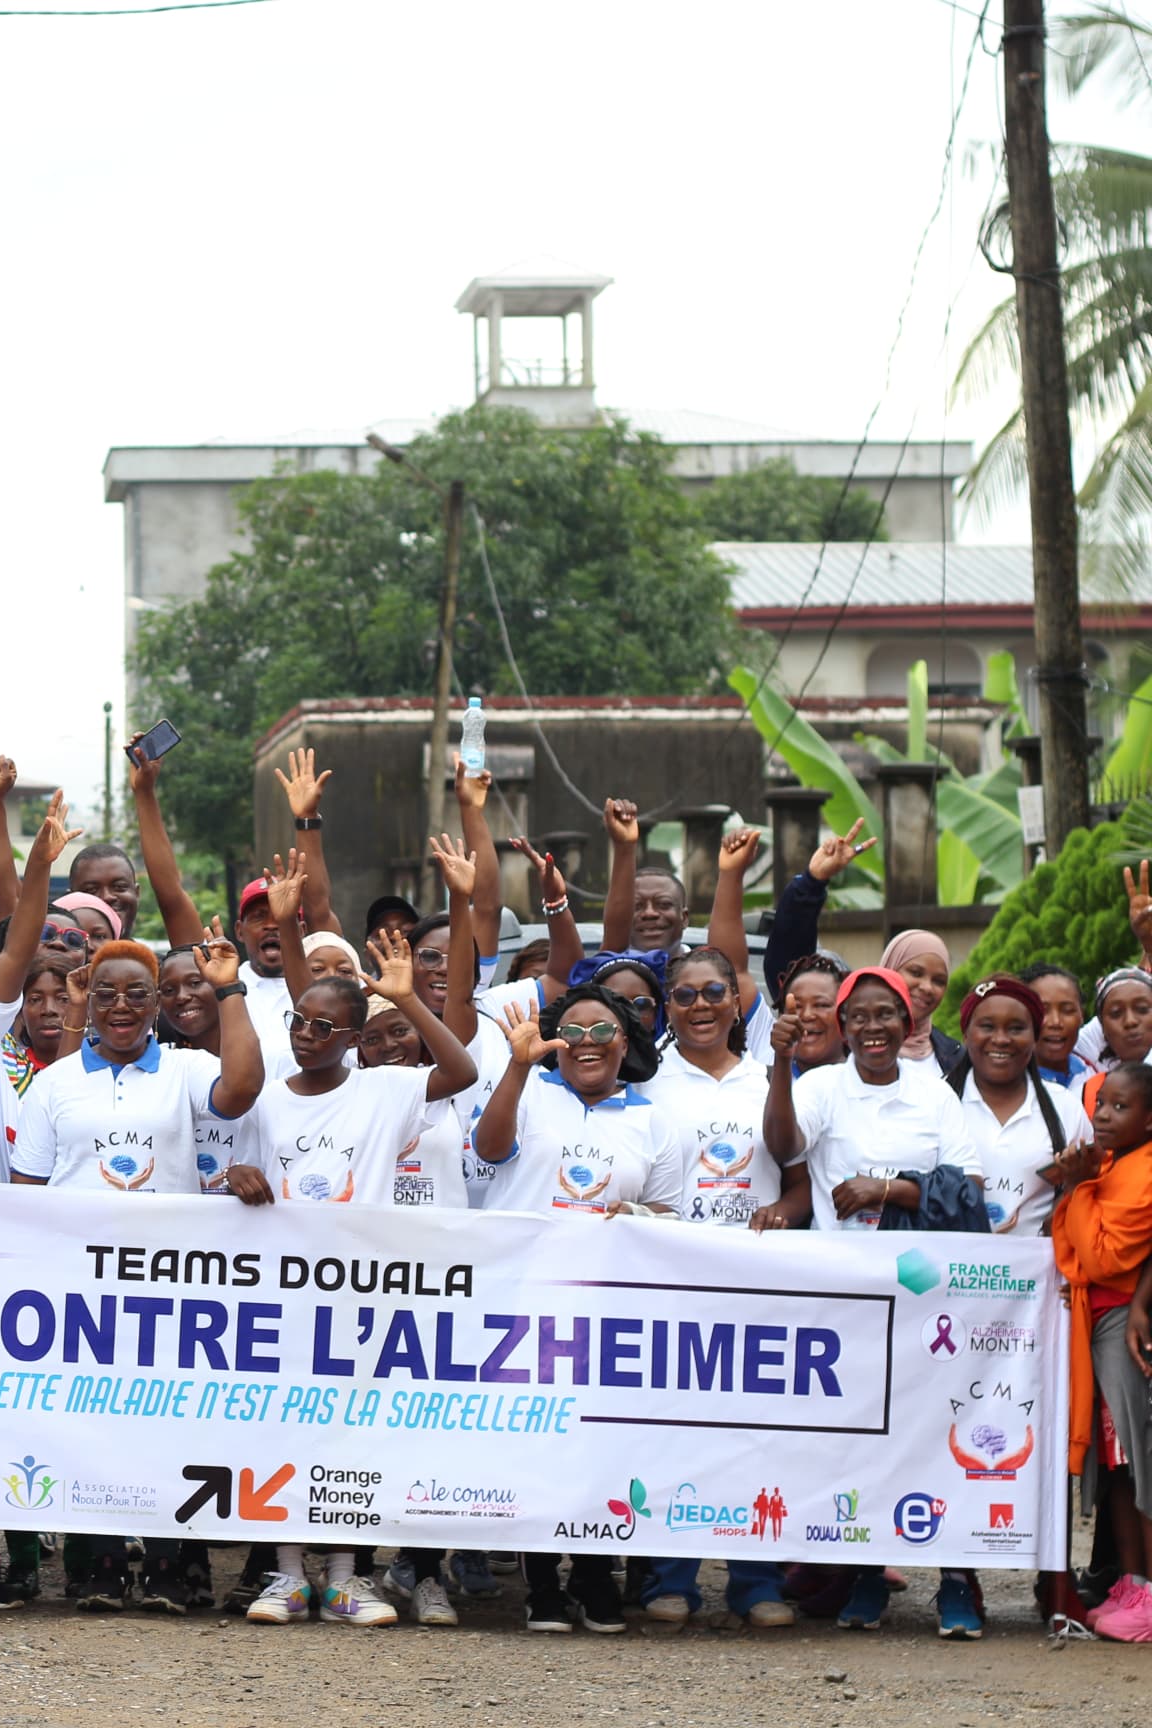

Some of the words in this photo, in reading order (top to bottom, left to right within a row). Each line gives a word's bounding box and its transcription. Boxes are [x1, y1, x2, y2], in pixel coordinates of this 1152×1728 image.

[94, 1131, 153, 1152] ACMA
[697, 1122, 753, 1142] ACMA
[279, 1135, 354, 1170] ACMA
[562, 1144, 615, 1167] ACMA
[393, 1190, 434, 1201] ONTH
[983, 1177, 1024, 1196] CMA
[712, 1207, 754, 1219] MONT
[87, 1245, 261, 1287] TEAMS
[279, 1256, 472, 1297] DOUALA
[949, 1263, 1010, 1278] FRANCE
[948, 1277, 1036, 1292] ALZHEIMER
[991, 1320, 1015, 1328] WORLD
[312, 1306, 844, 1397] L'ALZHEIMER
[970, 1337, 1035, 1353] MONTH
[64, 1375, 194, 1418] MALADIE
[196, 1380, 278, 1422] N'EST
[280, 1386, 338, 1425] PAS
[343, 1389, 381, 1428] LA
[386, 1391, 576, 1434] SORCELLERIE
[949, 1380, 1035, 1416] ACMA
[310, 1465, 382, 1488] Orange
[309, 1486, 375, 1508] Money
[431, 1479, 450, 1501] le
[452, 1487, 516, 1504] connu
[308, 1507, 381, 1529] Europe
[673, 1504, 748, 1524] JEDAG
[713, 1527, 747, 1537] SHOPS
[806, 1525, 841, 1542] DOUALA
[843, 1526, 871, 1543] CLINIC
